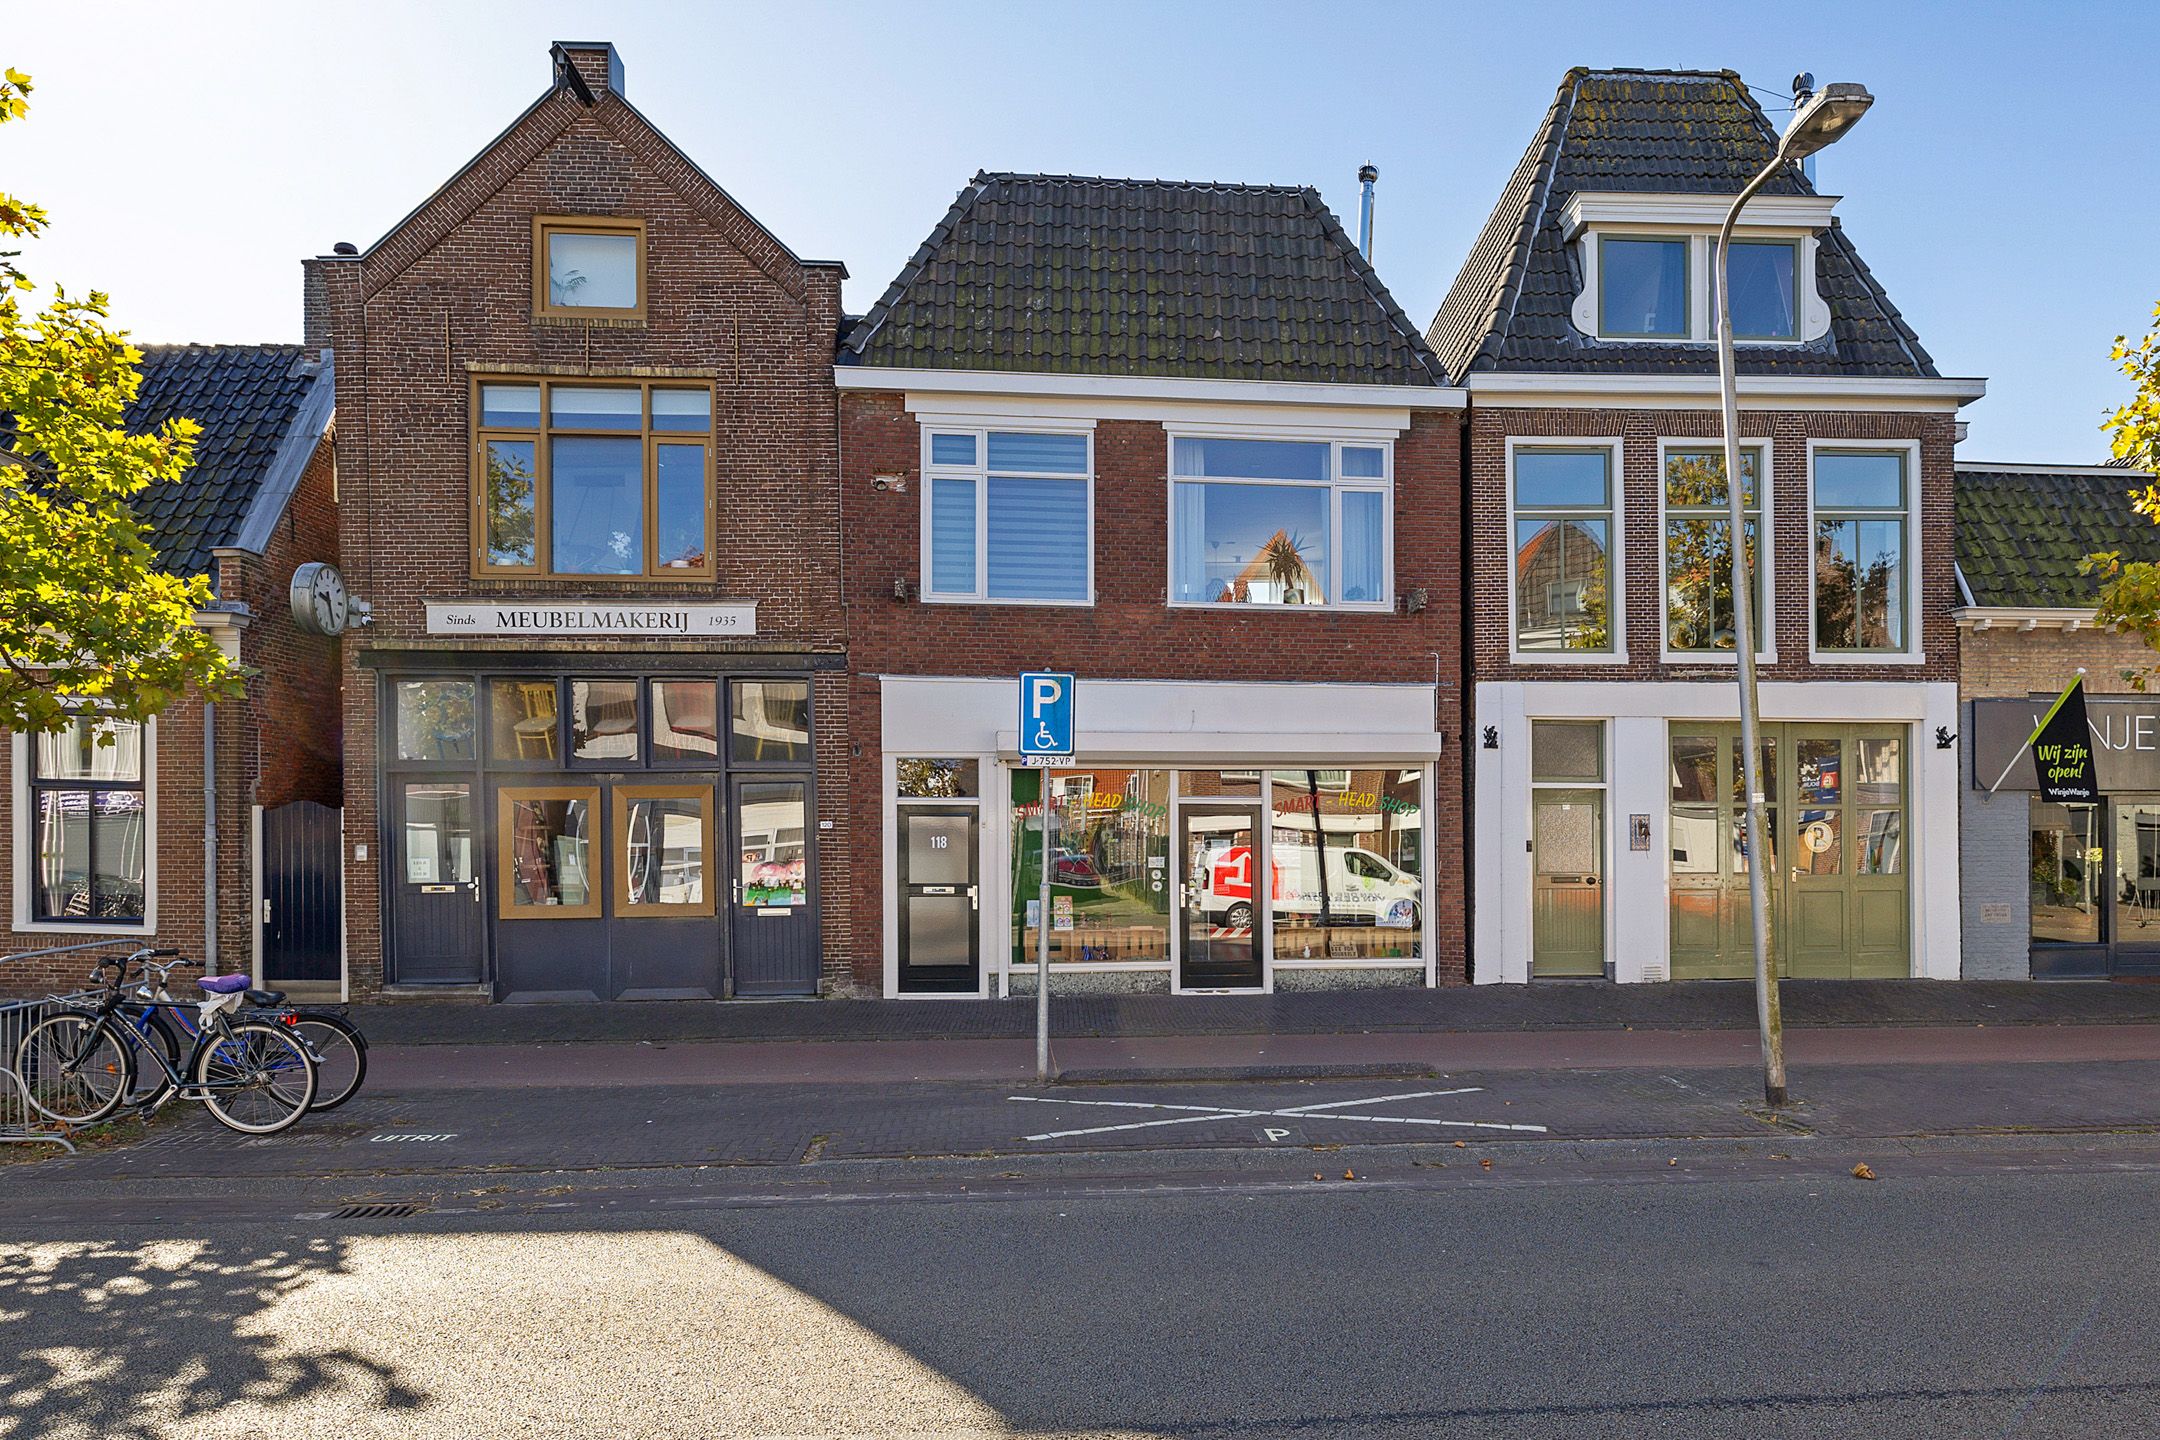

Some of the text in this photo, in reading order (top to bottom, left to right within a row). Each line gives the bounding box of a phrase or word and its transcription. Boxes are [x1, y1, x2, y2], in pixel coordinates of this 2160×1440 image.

[446, 611, 737, 633] Sinds MEUBELMAKERIJ 1935
[1033, 679, 1062, 718] P
[2038, 744, 2088, 765] Wij zijn
[2048, 762, 2085, 784] open!
[2048, 788, 2090, 797] WinjeWanje
[1083, 791, 1123, 808] HEAD
[1124, 796, 1167, 817] SHOP
[1274, 793, 1323, 817] SMART
[1338, 791, 1376, 808] HEAD
[1379, 796, 1418, 817] SHOP
[930, 836, 947, 848] 118
[370, 1134, 458, 1142] UITRIT
[1263, 1128, 1290, 1141] P
